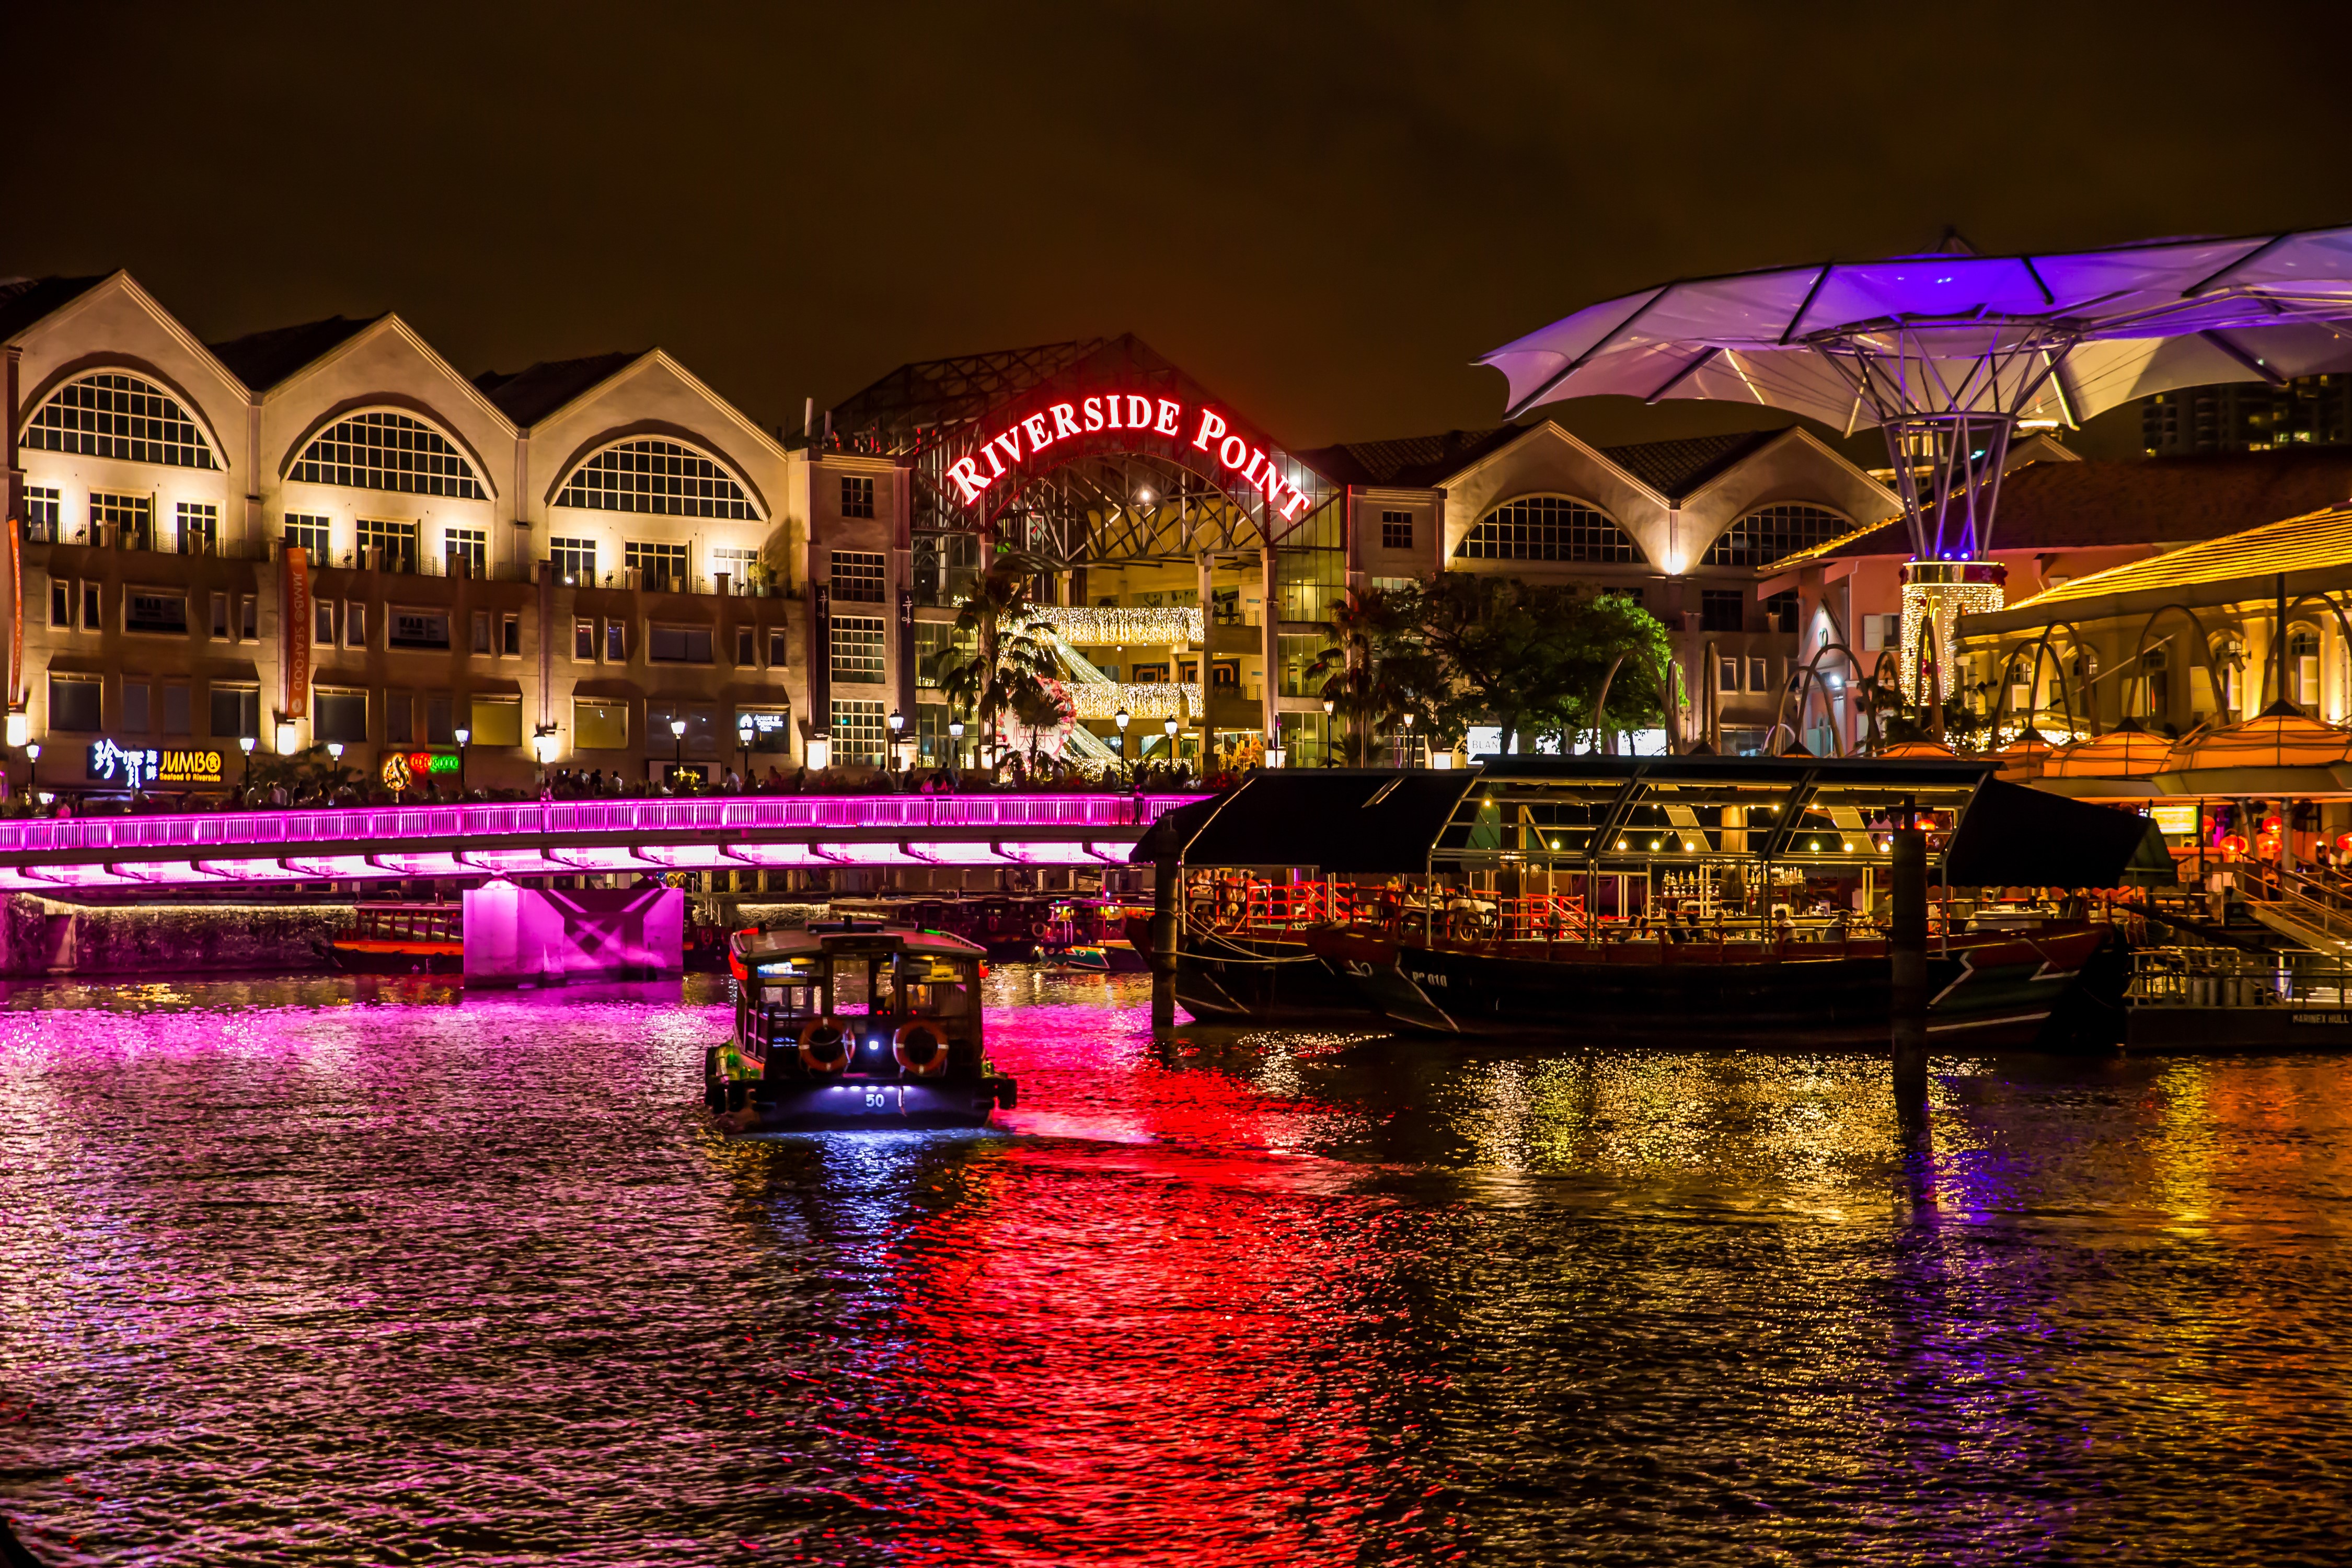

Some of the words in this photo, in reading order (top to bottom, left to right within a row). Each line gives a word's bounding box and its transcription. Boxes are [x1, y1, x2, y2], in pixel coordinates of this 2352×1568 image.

[947, 395, 1180, 505] RIVERSIDE
[1193, 409, 1311, 521] POINT
[293, 571, 305, 621] JUMBO
[294, 626, 305, 691] SEAFOOD
[159, 751, 221, 774] JUMBO
[193, 773, 221, 781] Riverside
[1427, 973, 1447, 987] 010
[866, 1093, 885, 1108] 50
